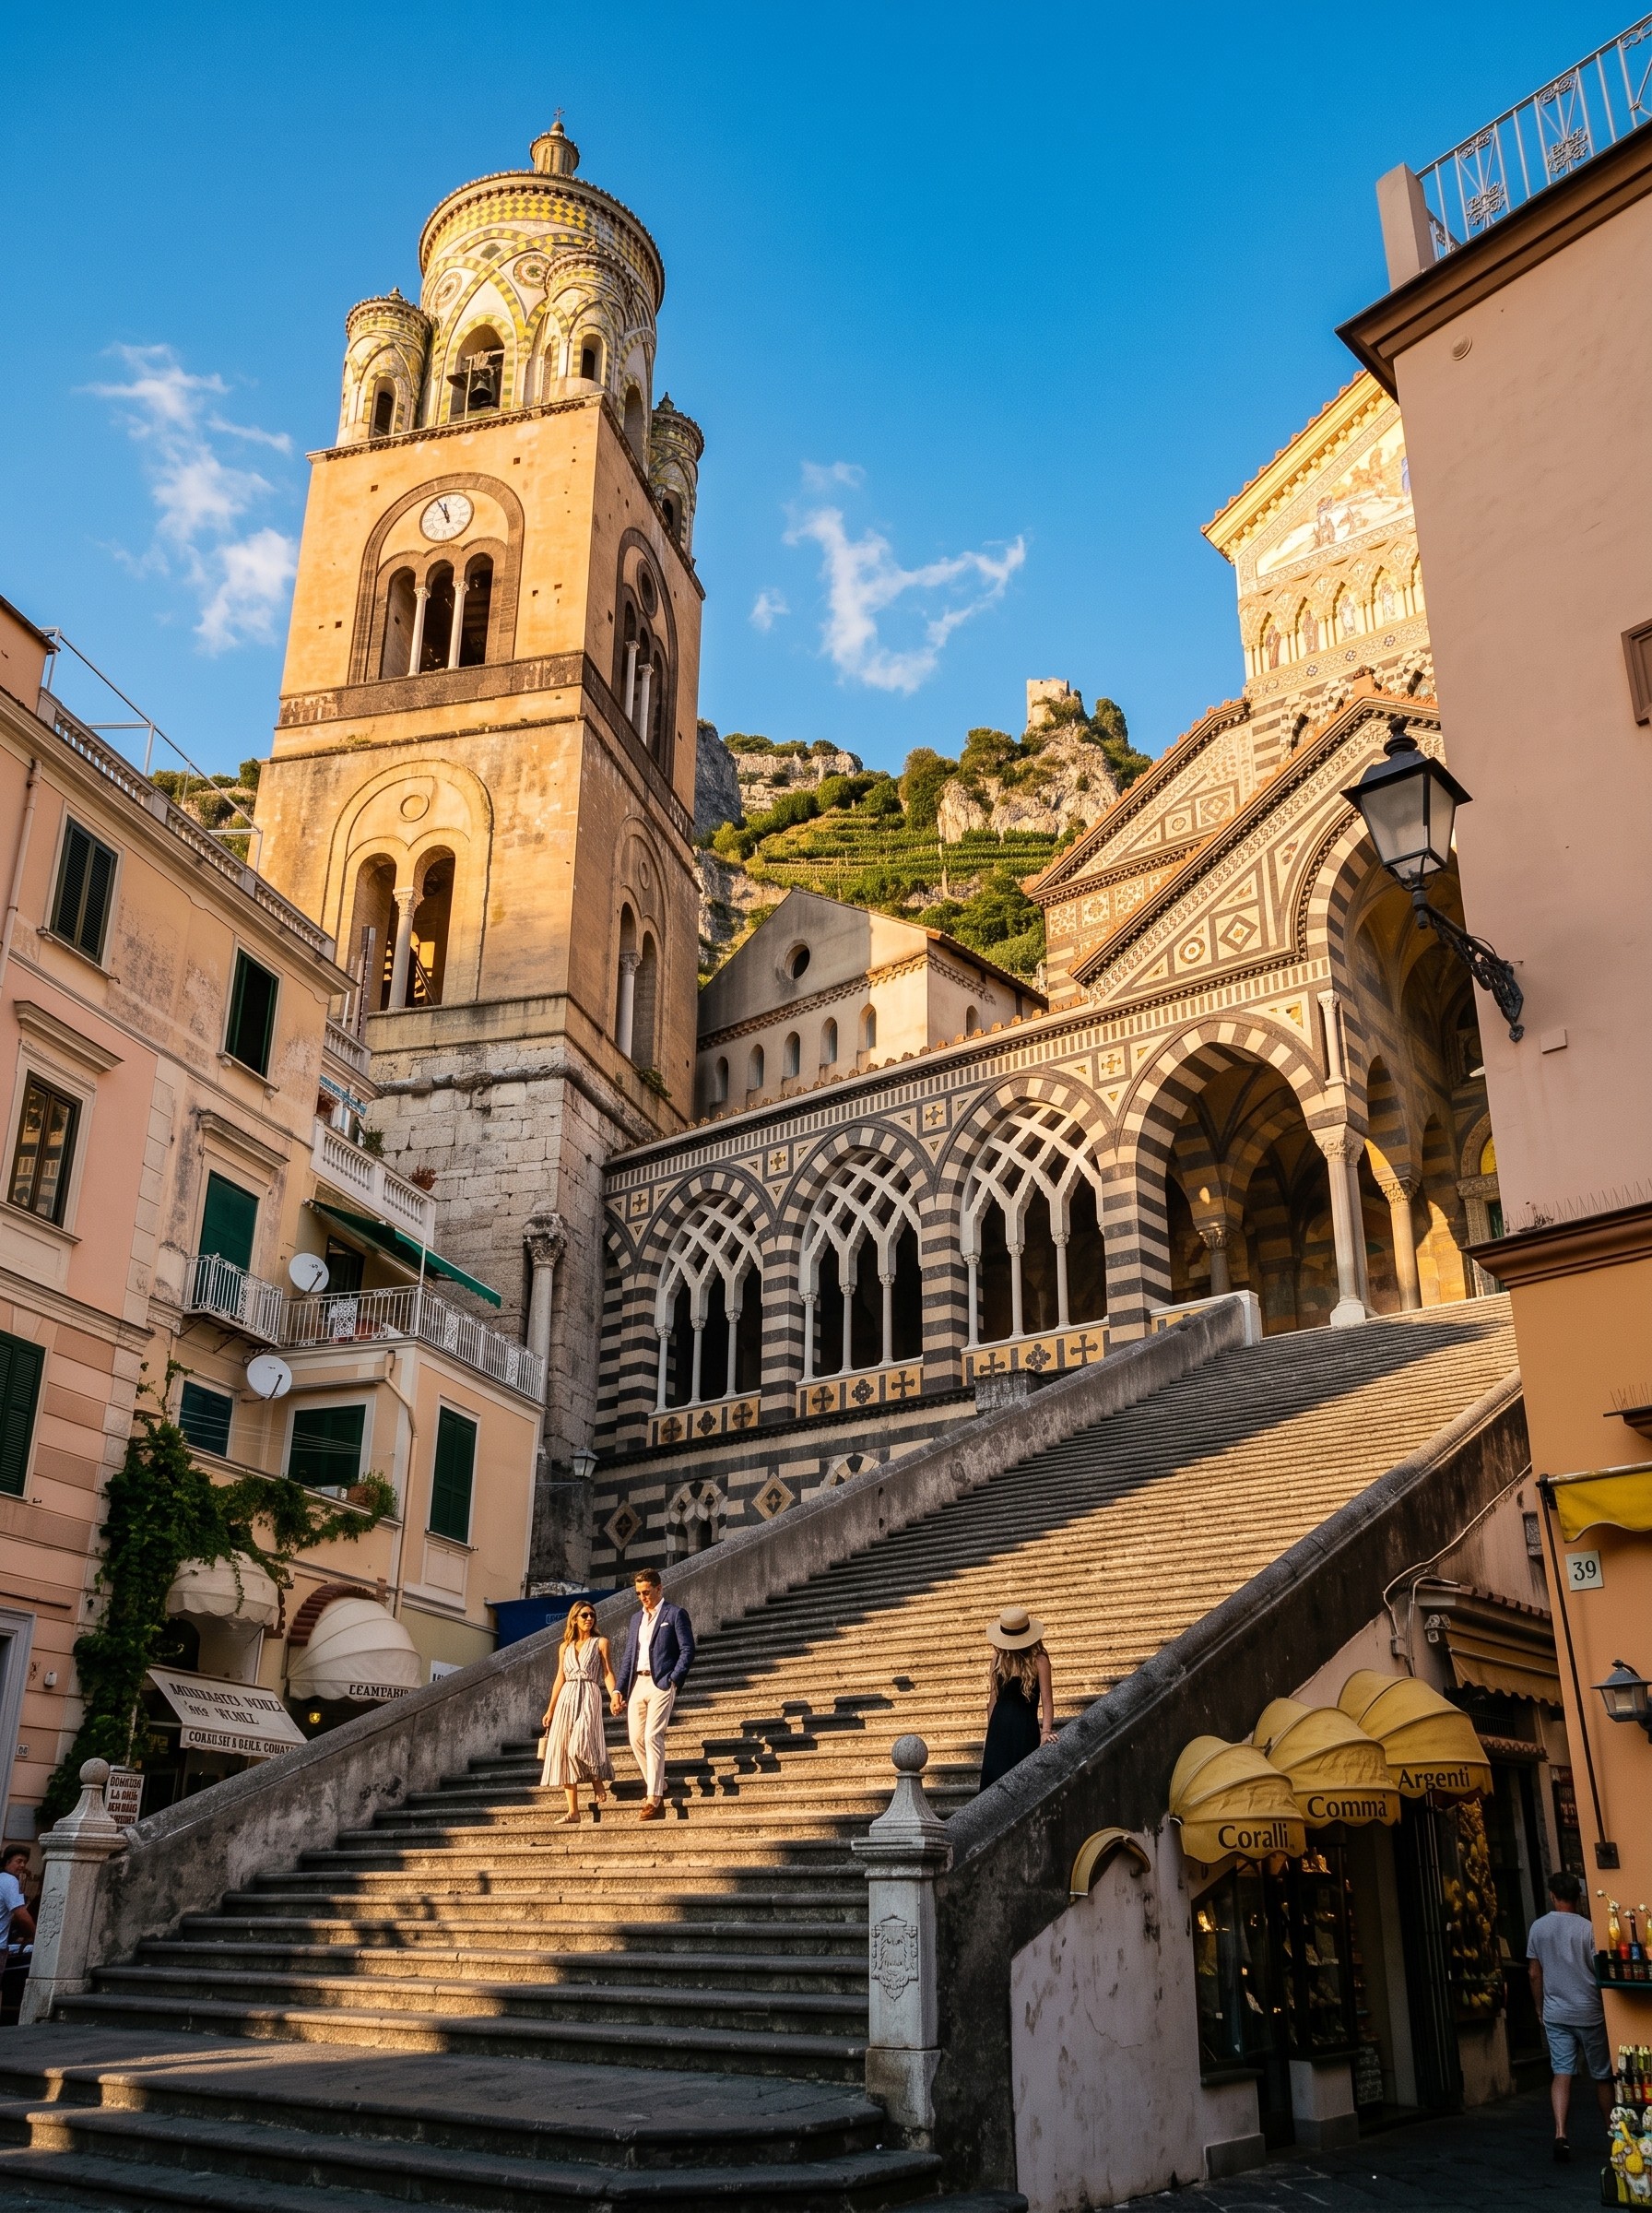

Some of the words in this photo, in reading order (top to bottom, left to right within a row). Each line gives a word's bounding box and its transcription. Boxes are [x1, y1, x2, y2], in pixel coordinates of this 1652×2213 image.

[1573, 1559, 1597, 1580] 39
[1398, 1766, 1470, 1790] Argenti
[1218, 1823, 1289, 1849] Coralli
